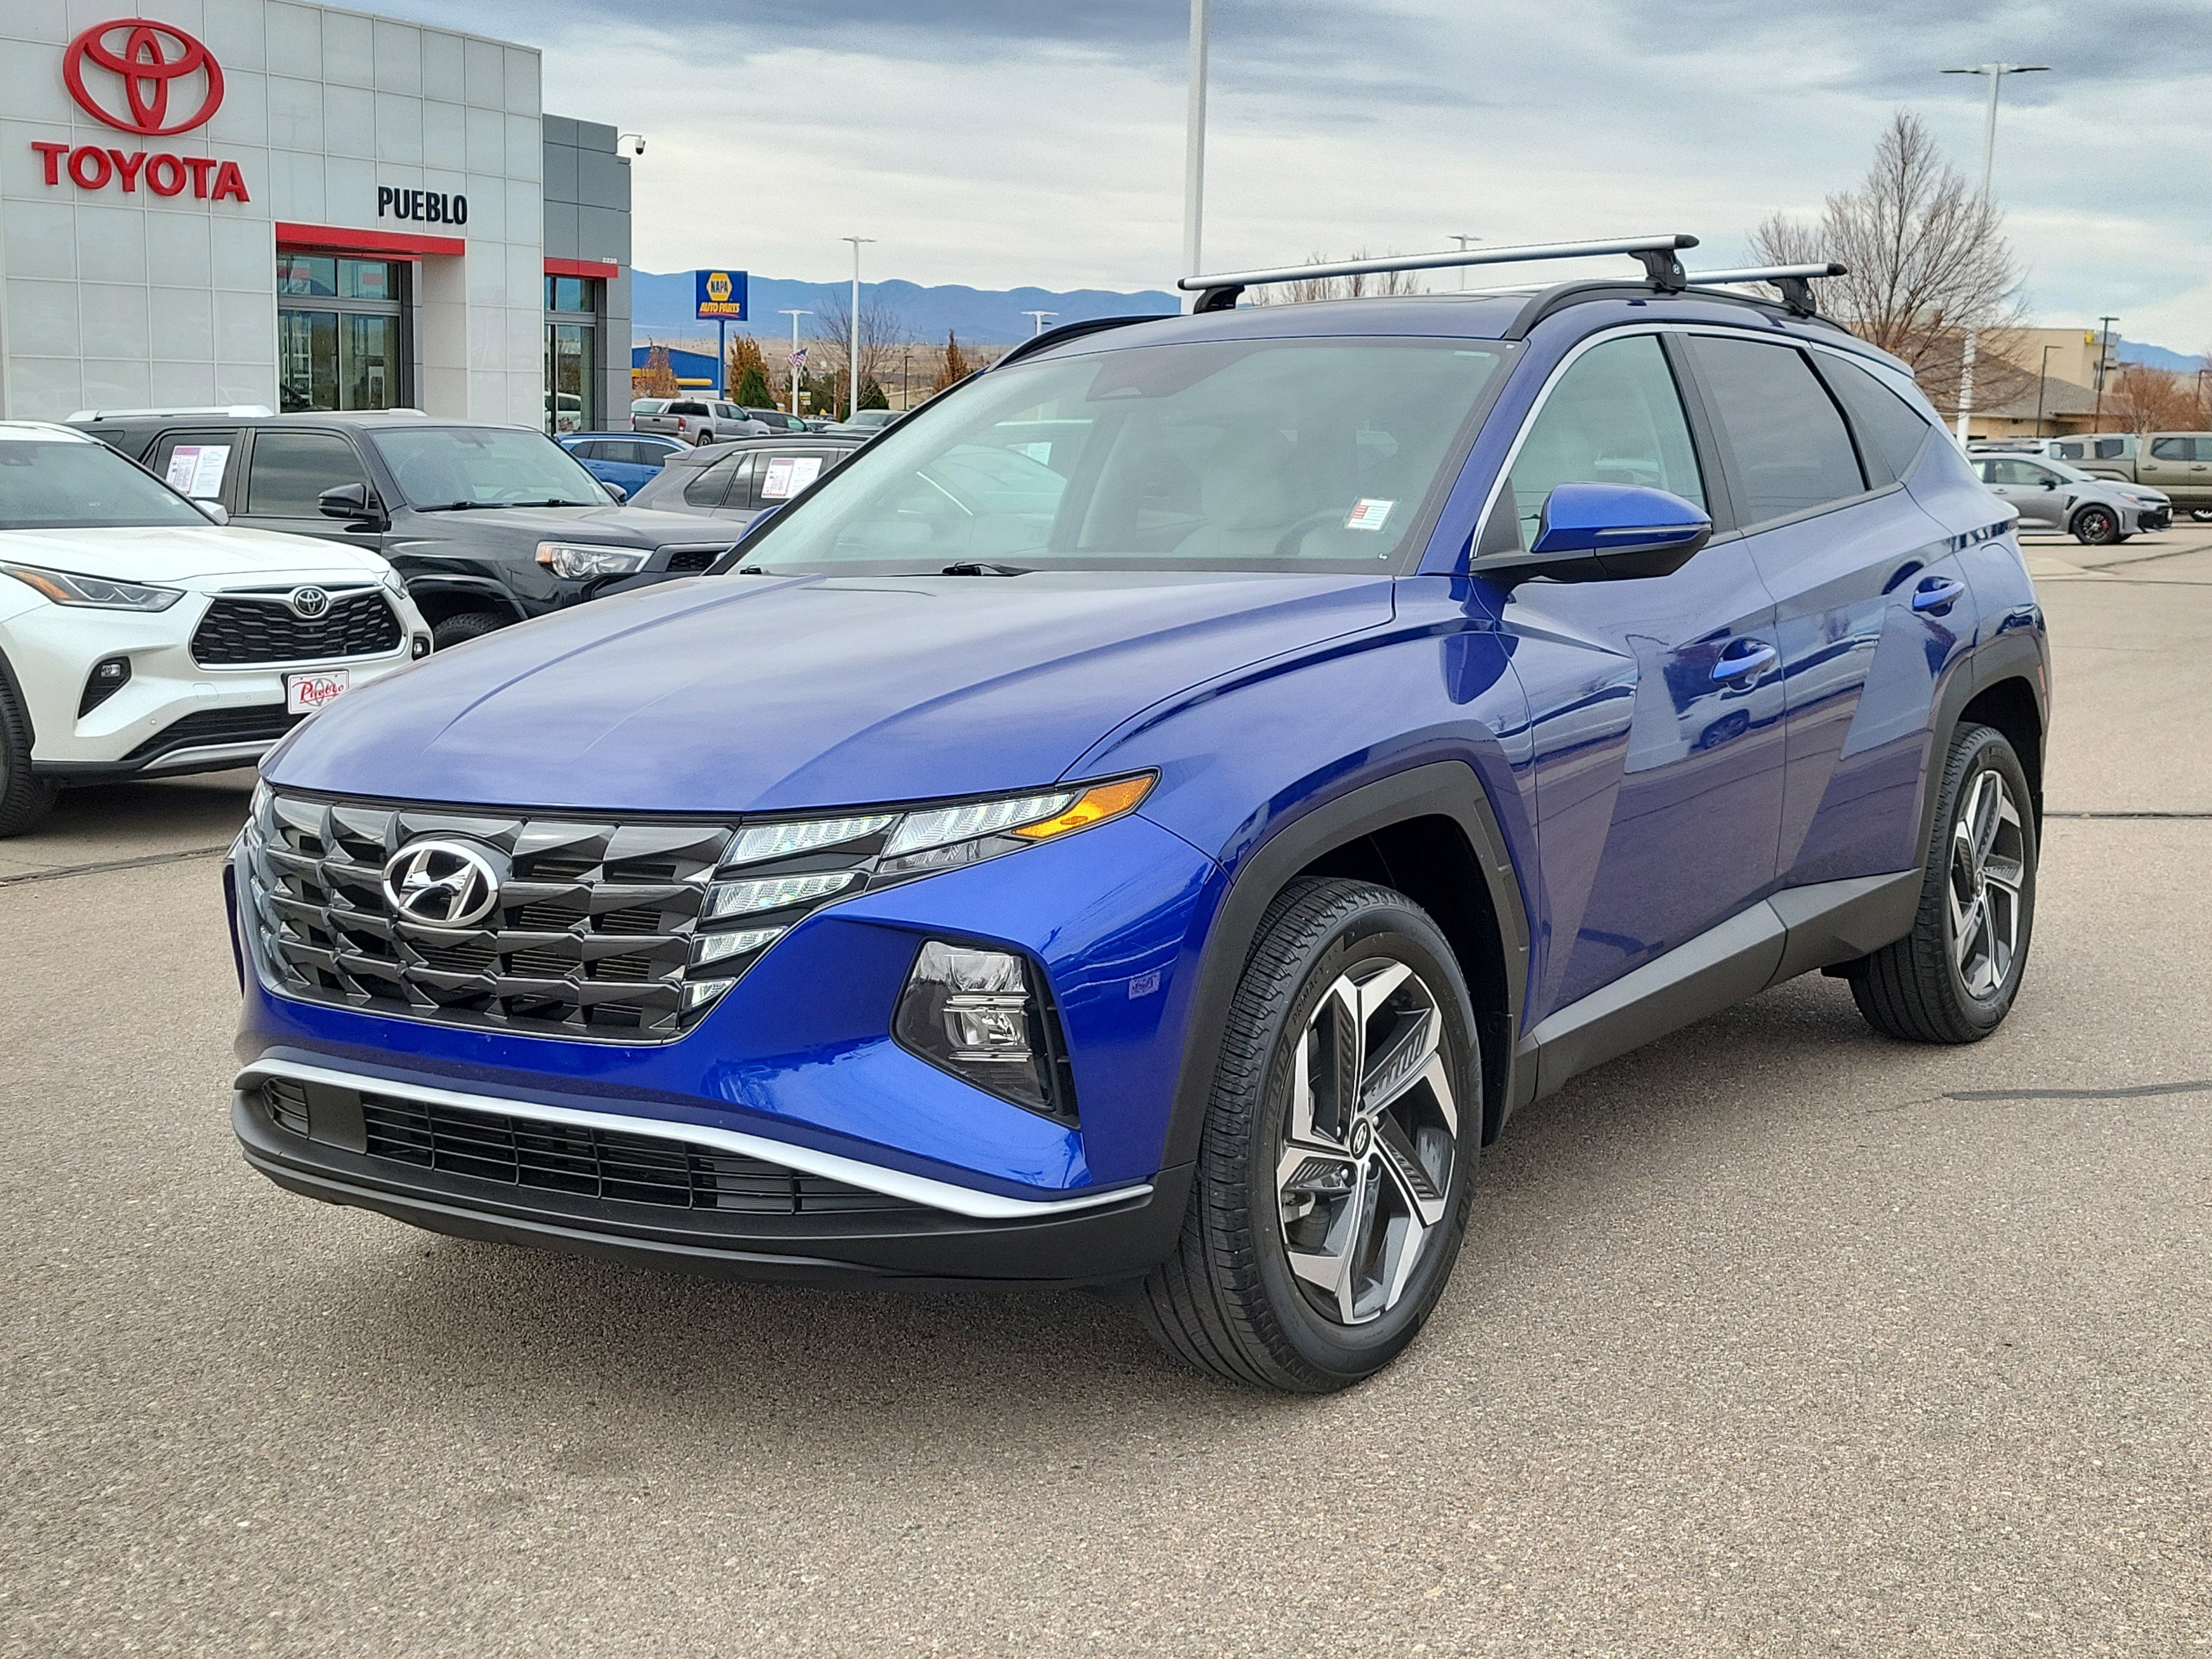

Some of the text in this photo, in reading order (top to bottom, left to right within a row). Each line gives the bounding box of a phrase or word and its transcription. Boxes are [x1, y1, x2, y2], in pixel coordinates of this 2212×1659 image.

[31, 141, 250, 202] TOYOTA
[378, 186, 468, 225] PUEBLO
[711, 280, 728, 293] NAPA
[700, 302, 740, 314] AUTO PARTS
[292, 681, 344, 701] Pueblo
